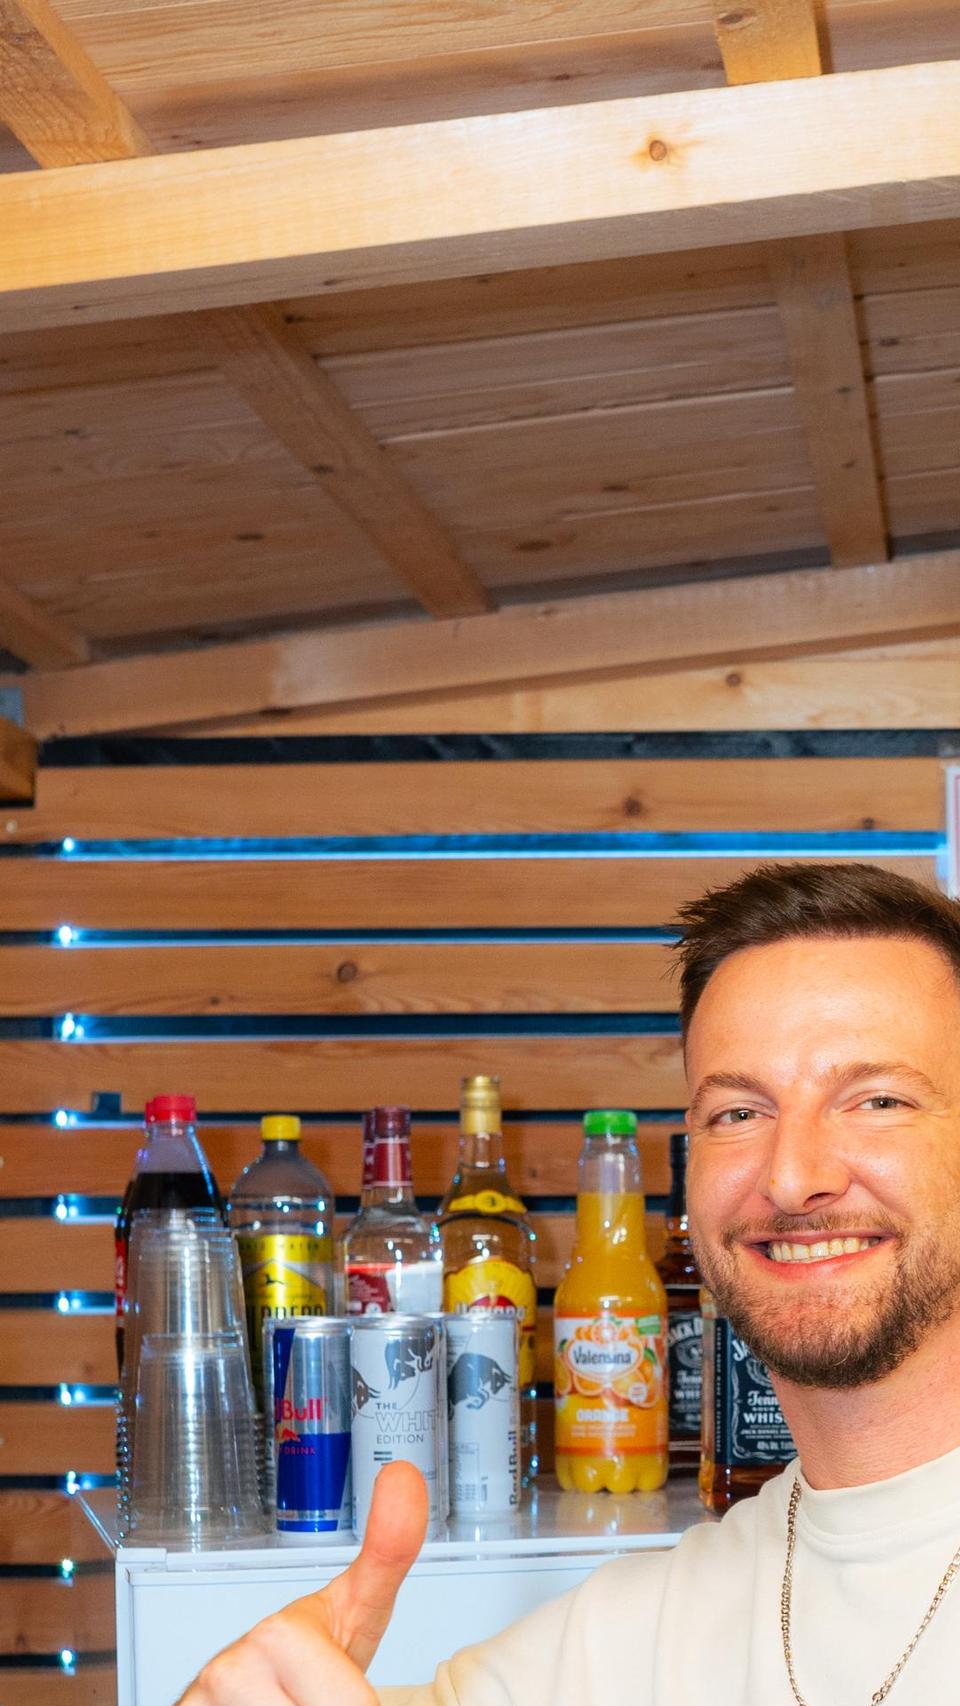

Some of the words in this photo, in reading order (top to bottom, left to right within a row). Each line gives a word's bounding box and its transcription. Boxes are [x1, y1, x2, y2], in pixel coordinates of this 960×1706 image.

[573, 1345, 633, 1365] Valensina
[281, 1398, 321, 1422] Bull
[376, 1402, 398, 1410] THE
[375, 1410, 437, 1433] WHIT
[743, 1412, 784, 1424] WHIS
[376, 1434, 424, 1445] EDITION
